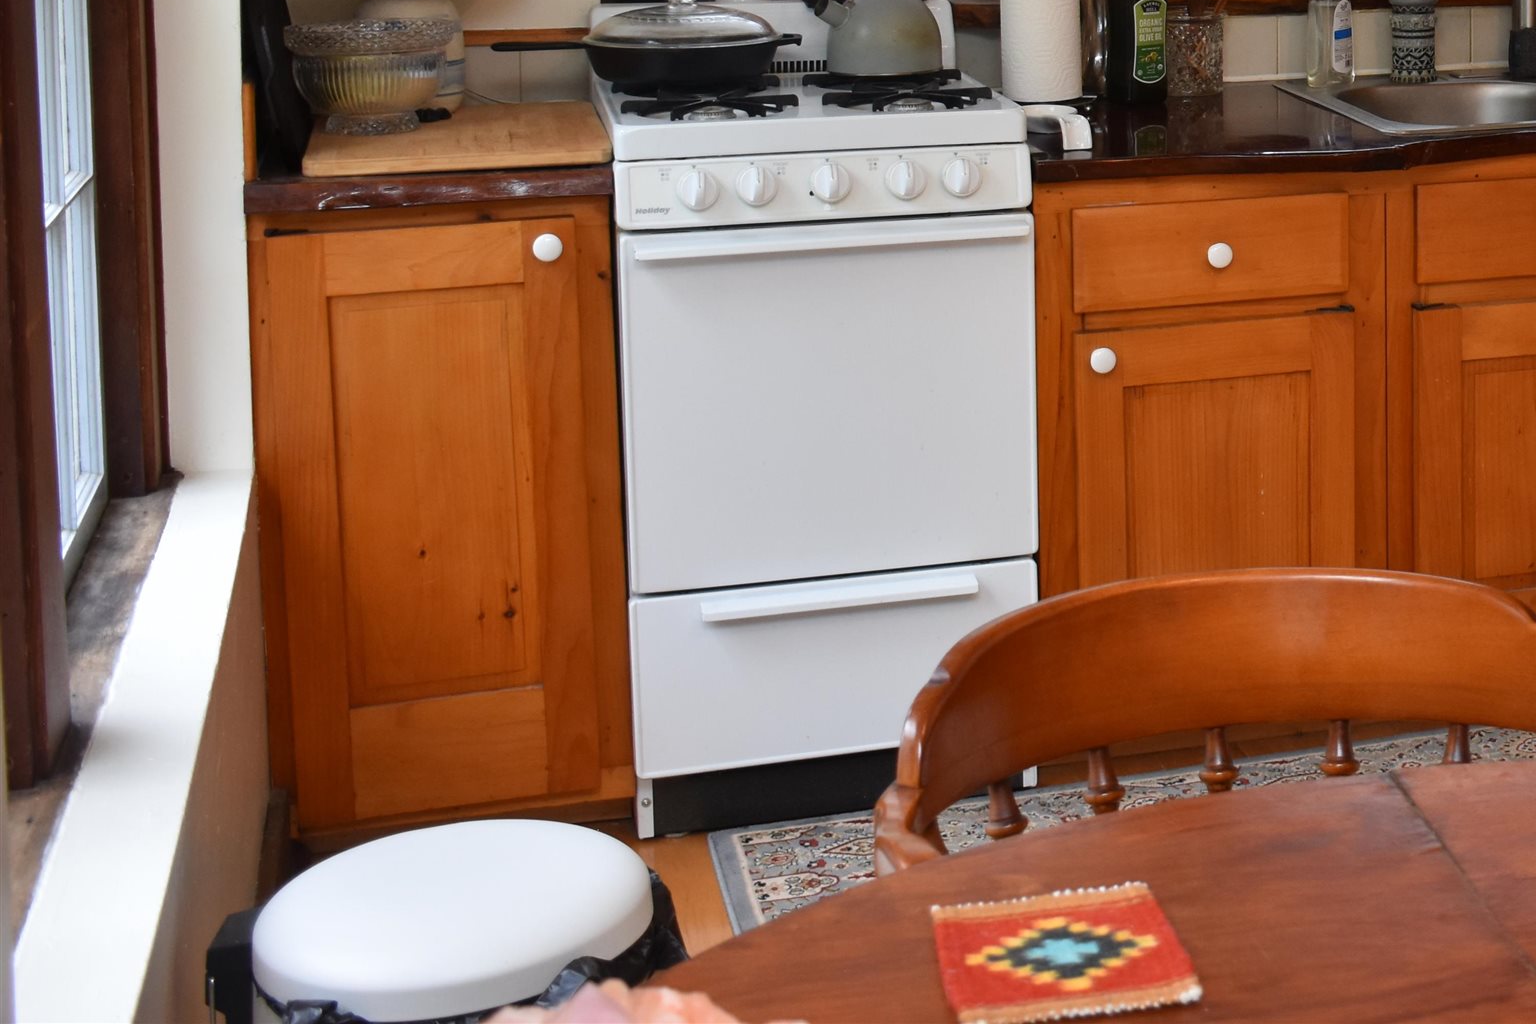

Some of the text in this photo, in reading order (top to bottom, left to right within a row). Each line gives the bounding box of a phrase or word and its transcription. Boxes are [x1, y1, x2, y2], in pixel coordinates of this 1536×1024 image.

[1139, 18, 1163, 27] ORGANIC
[1139, 33, 1155, 42] OLIVE
[635, 206, 671, 215] Holiday
